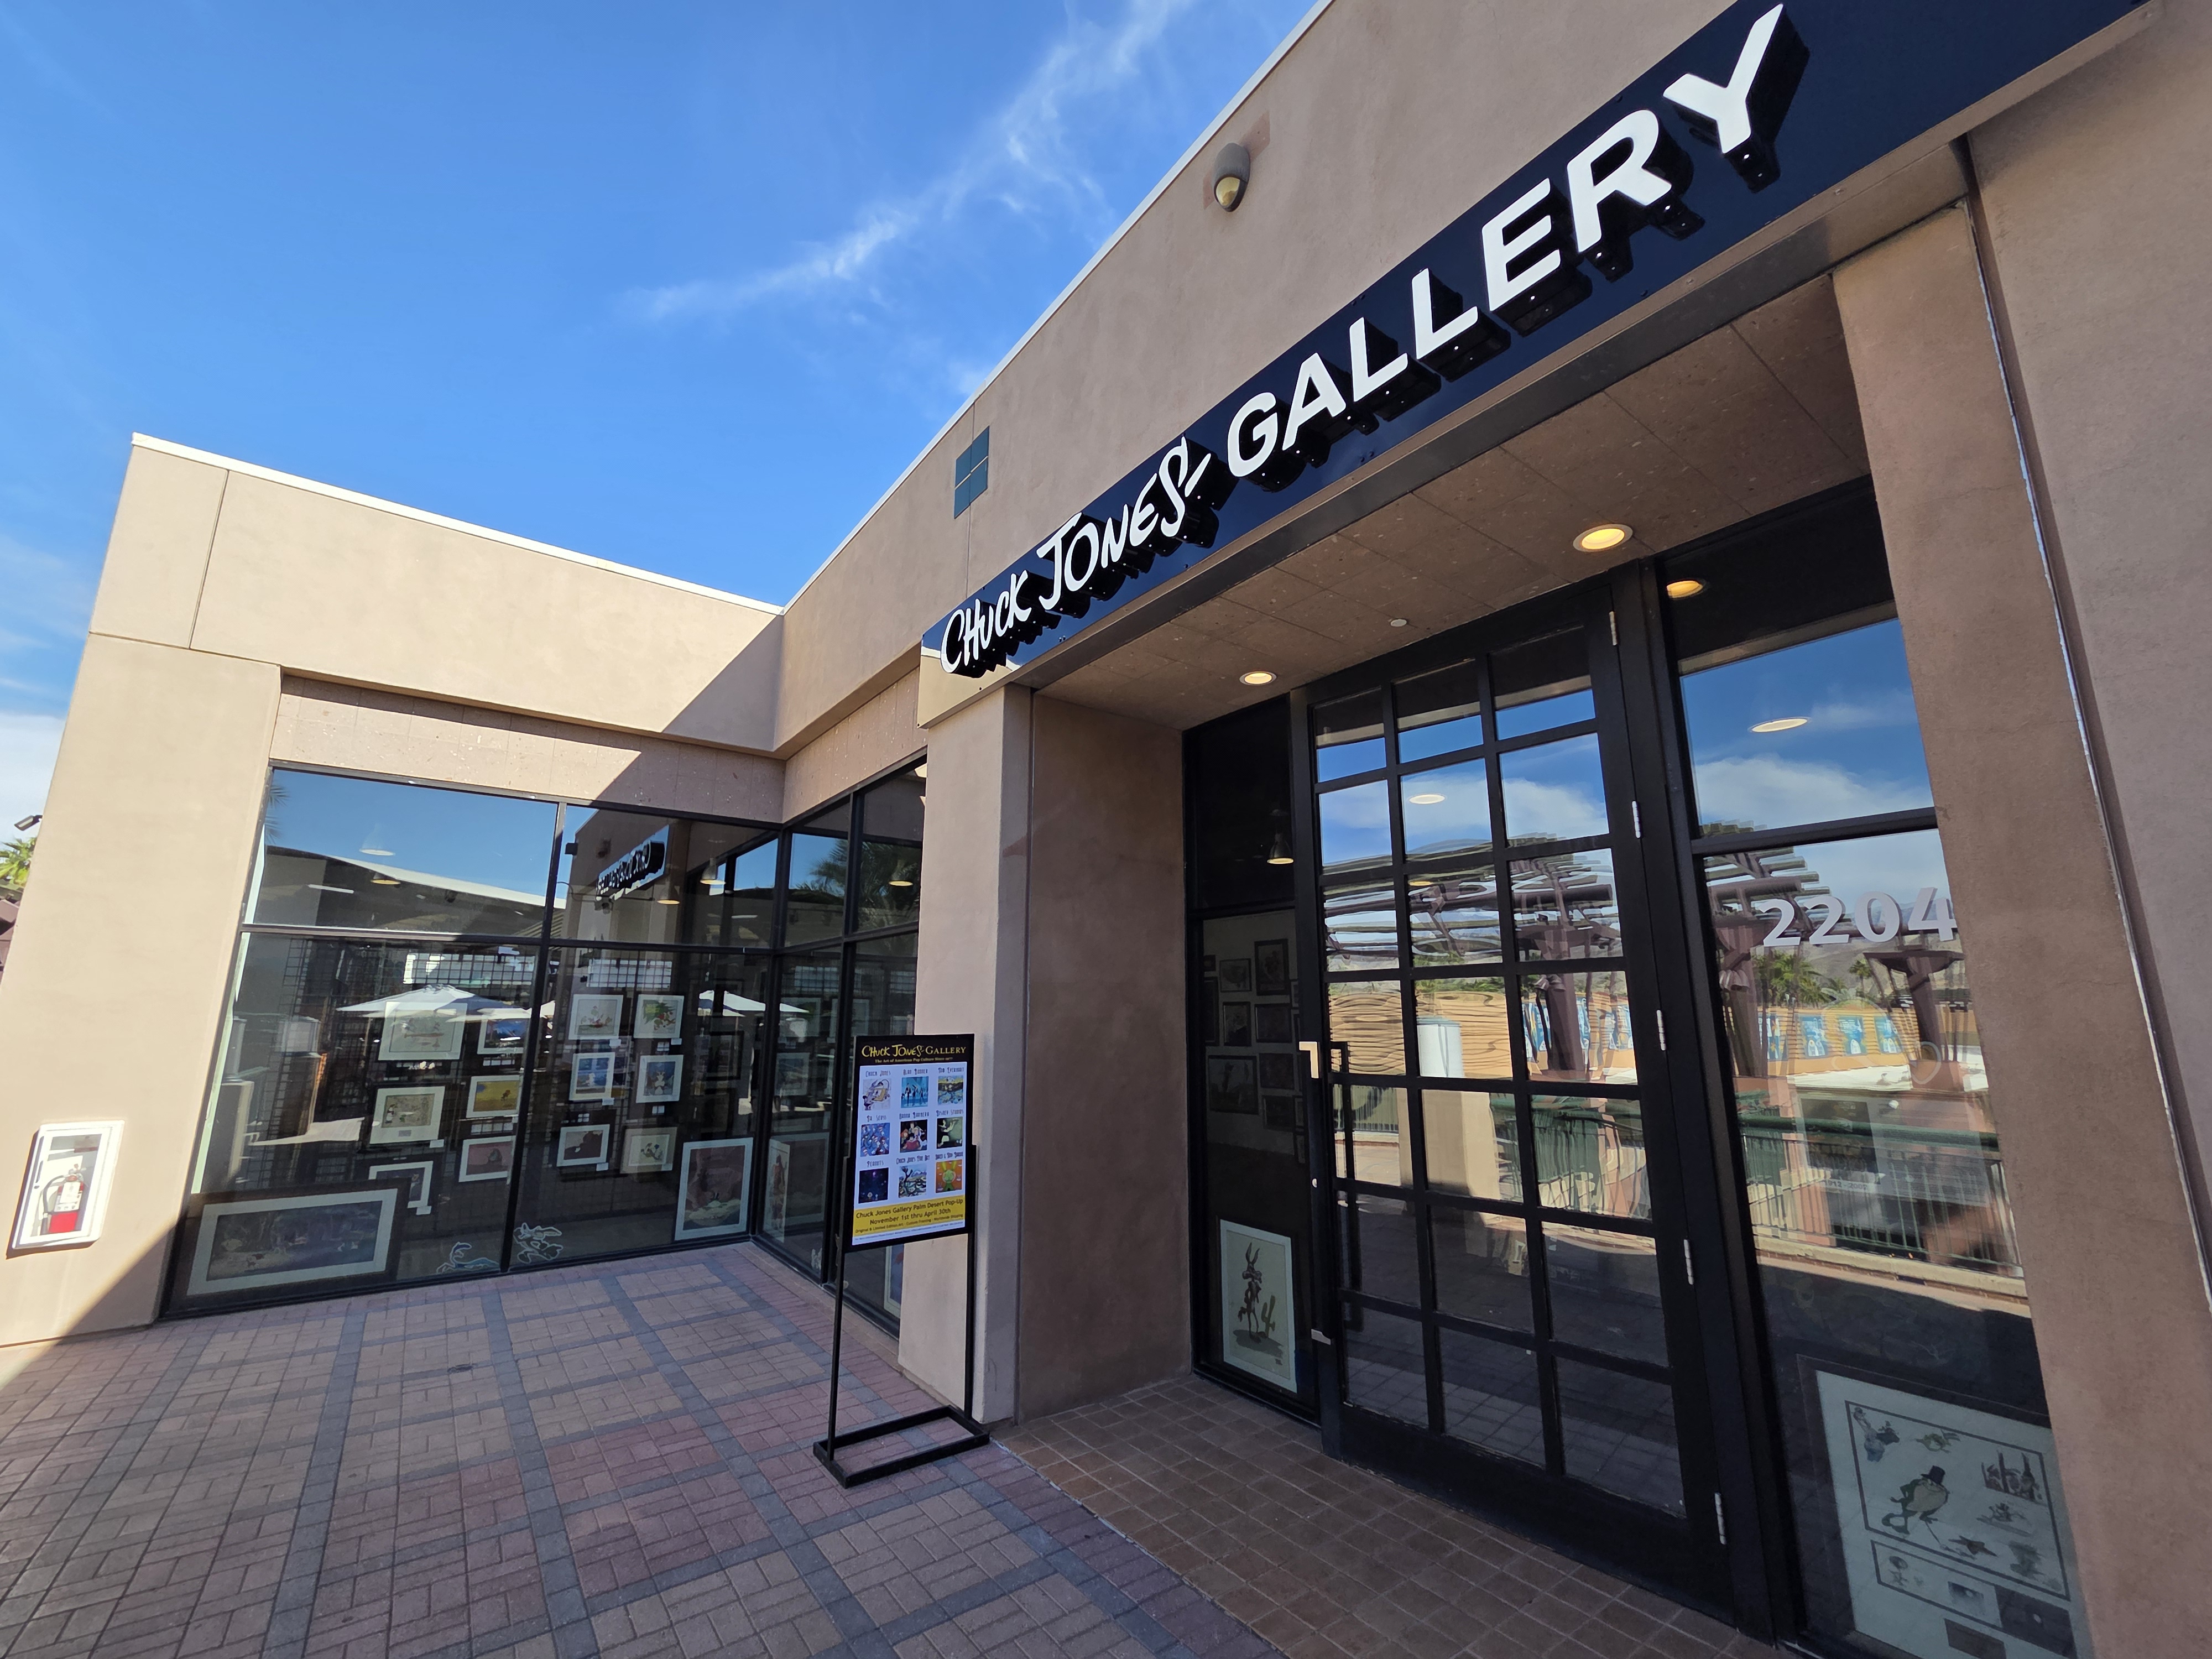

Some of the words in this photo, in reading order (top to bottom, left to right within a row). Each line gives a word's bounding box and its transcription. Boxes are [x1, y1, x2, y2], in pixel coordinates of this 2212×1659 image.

[941, 570, 1032, 674] CHUCK
[1036, 436, 1212, 611] JONES
[1227, 5, 1784, 477] GALLERY
[1757, 886, 1958, 948] 2204
[861, 1045, 891, 1057] CHUCK
[891, 1044, 924, 1057] JONES
[925, 1046, 966, 1055] GALLERY
[870, 1215, 899, 1225] November
